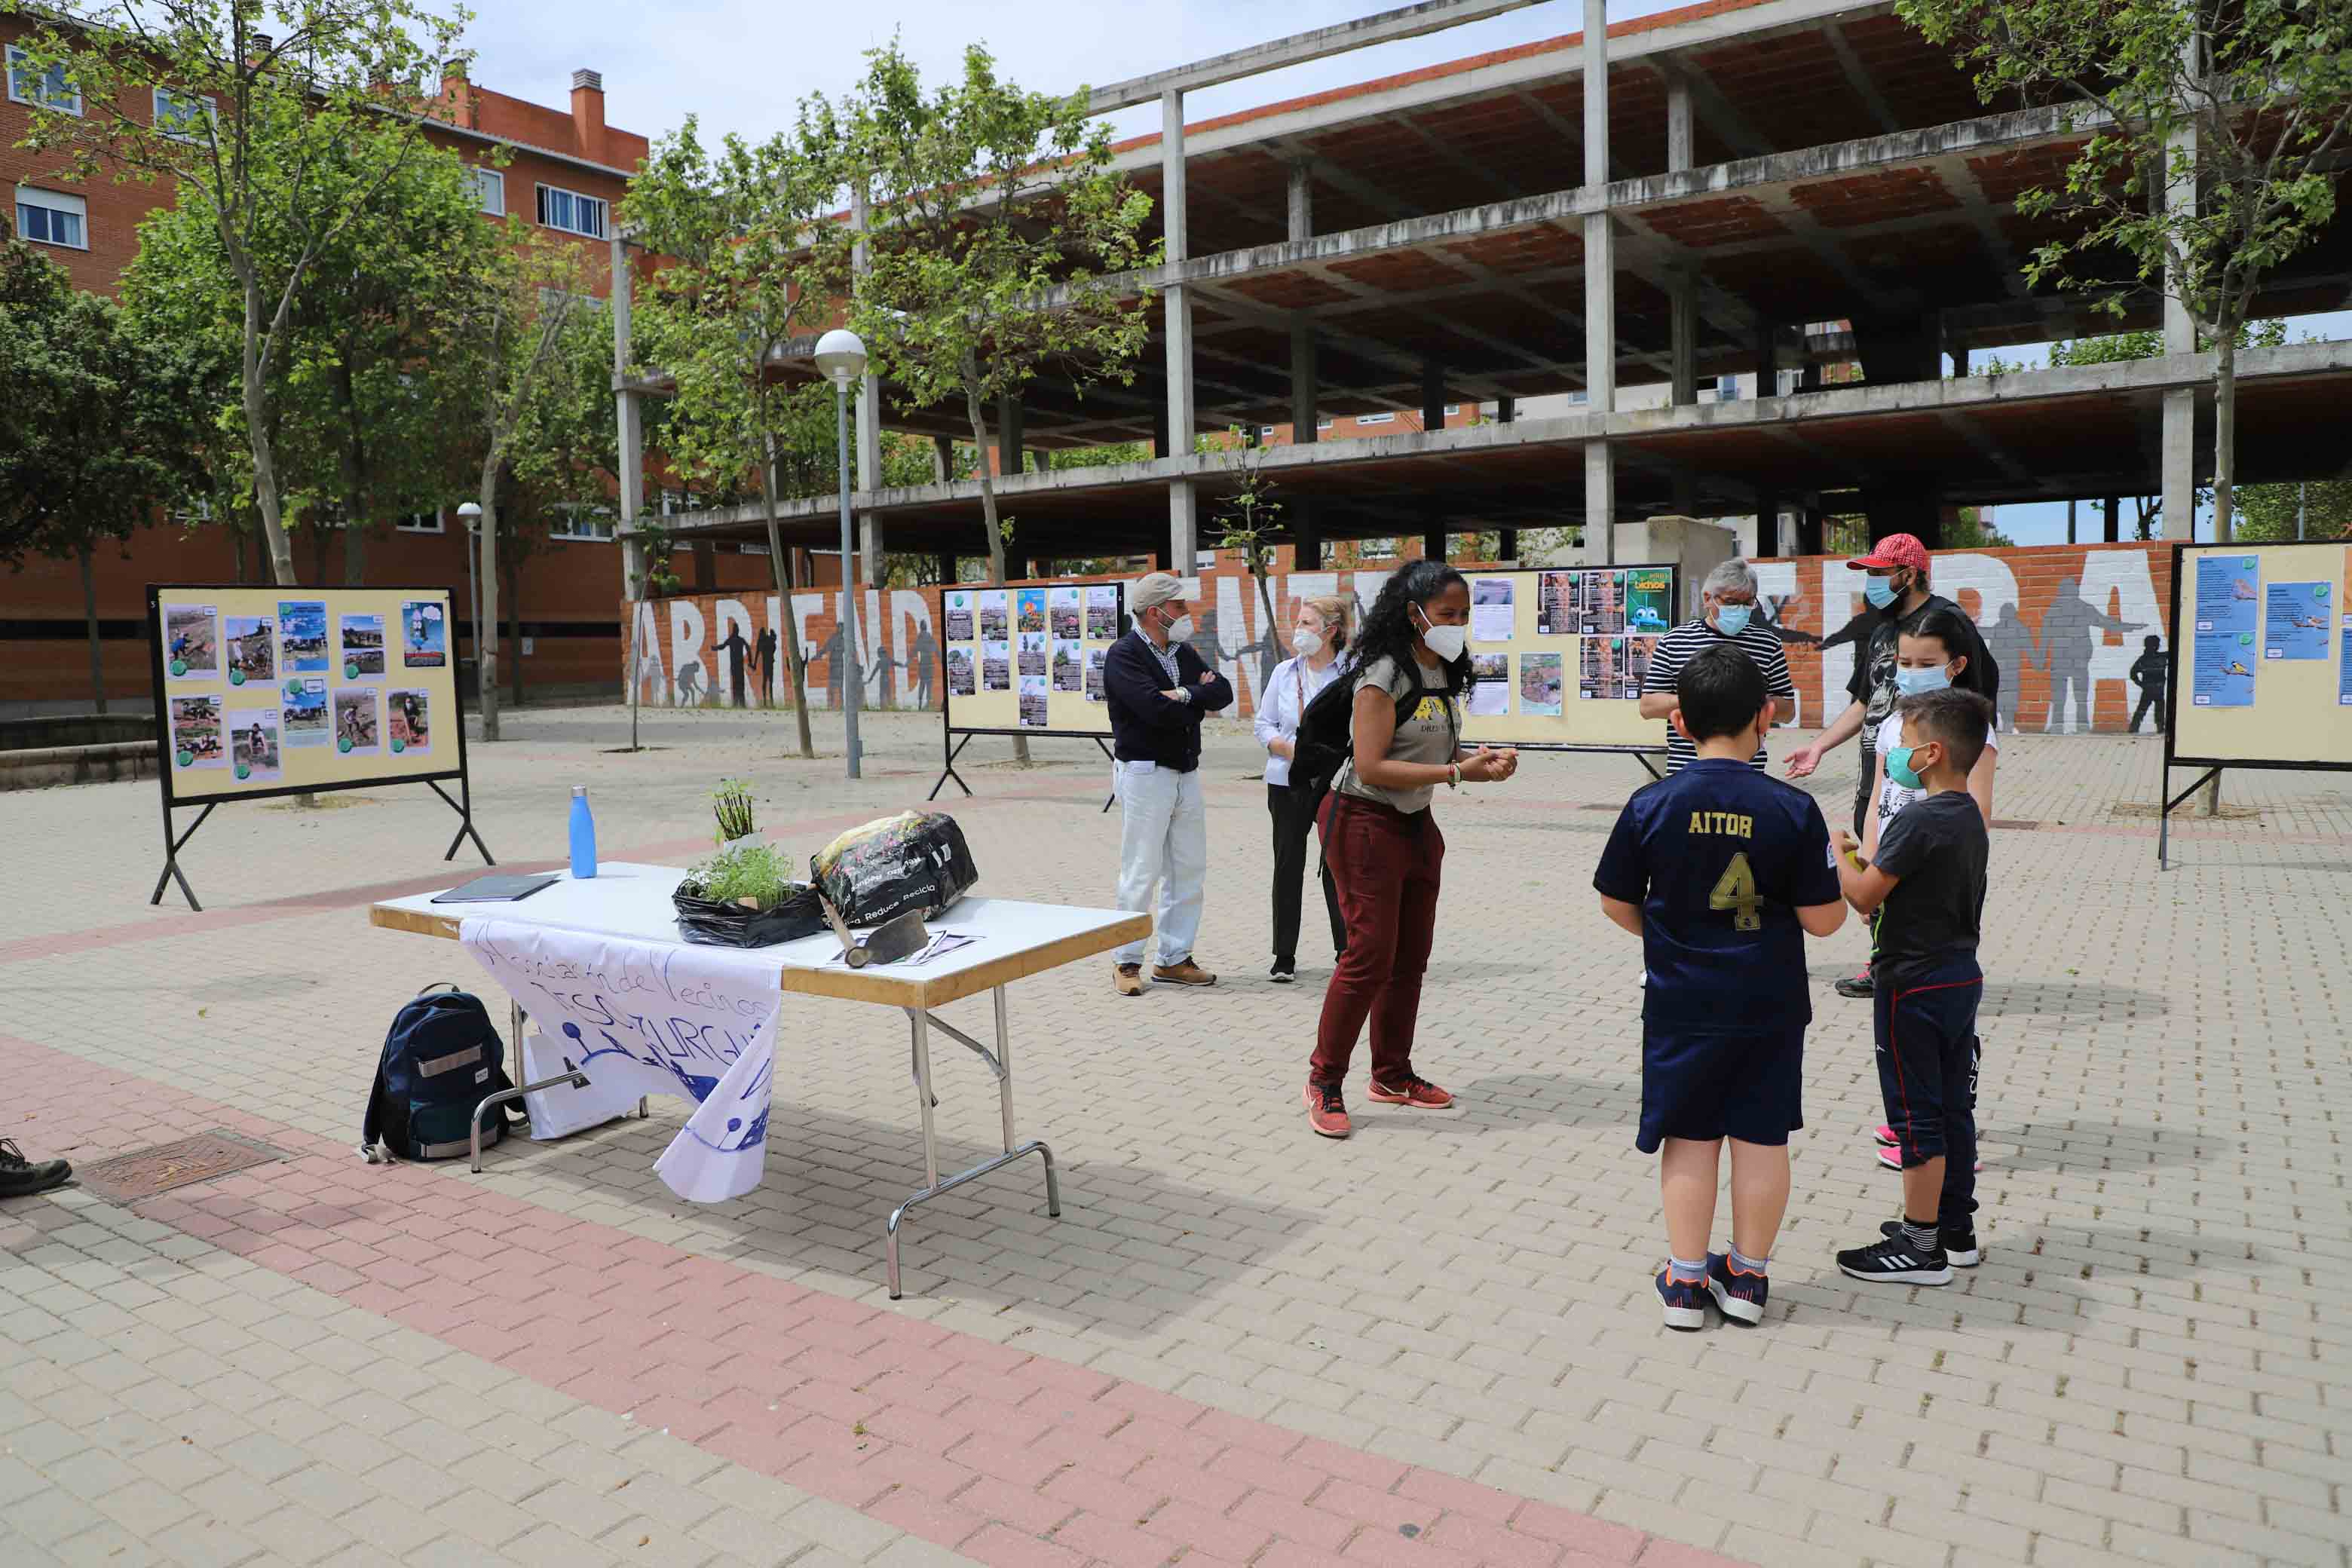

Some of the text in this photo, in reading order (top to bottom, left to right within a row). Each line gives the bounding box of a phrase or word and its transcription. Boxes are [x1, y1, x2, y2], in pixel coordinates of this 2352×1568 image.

[1689, 811, 1753, 839] AITOR
[1709, 852, 1764, 931] 4
[865, 901, 900, 922] Reduce
